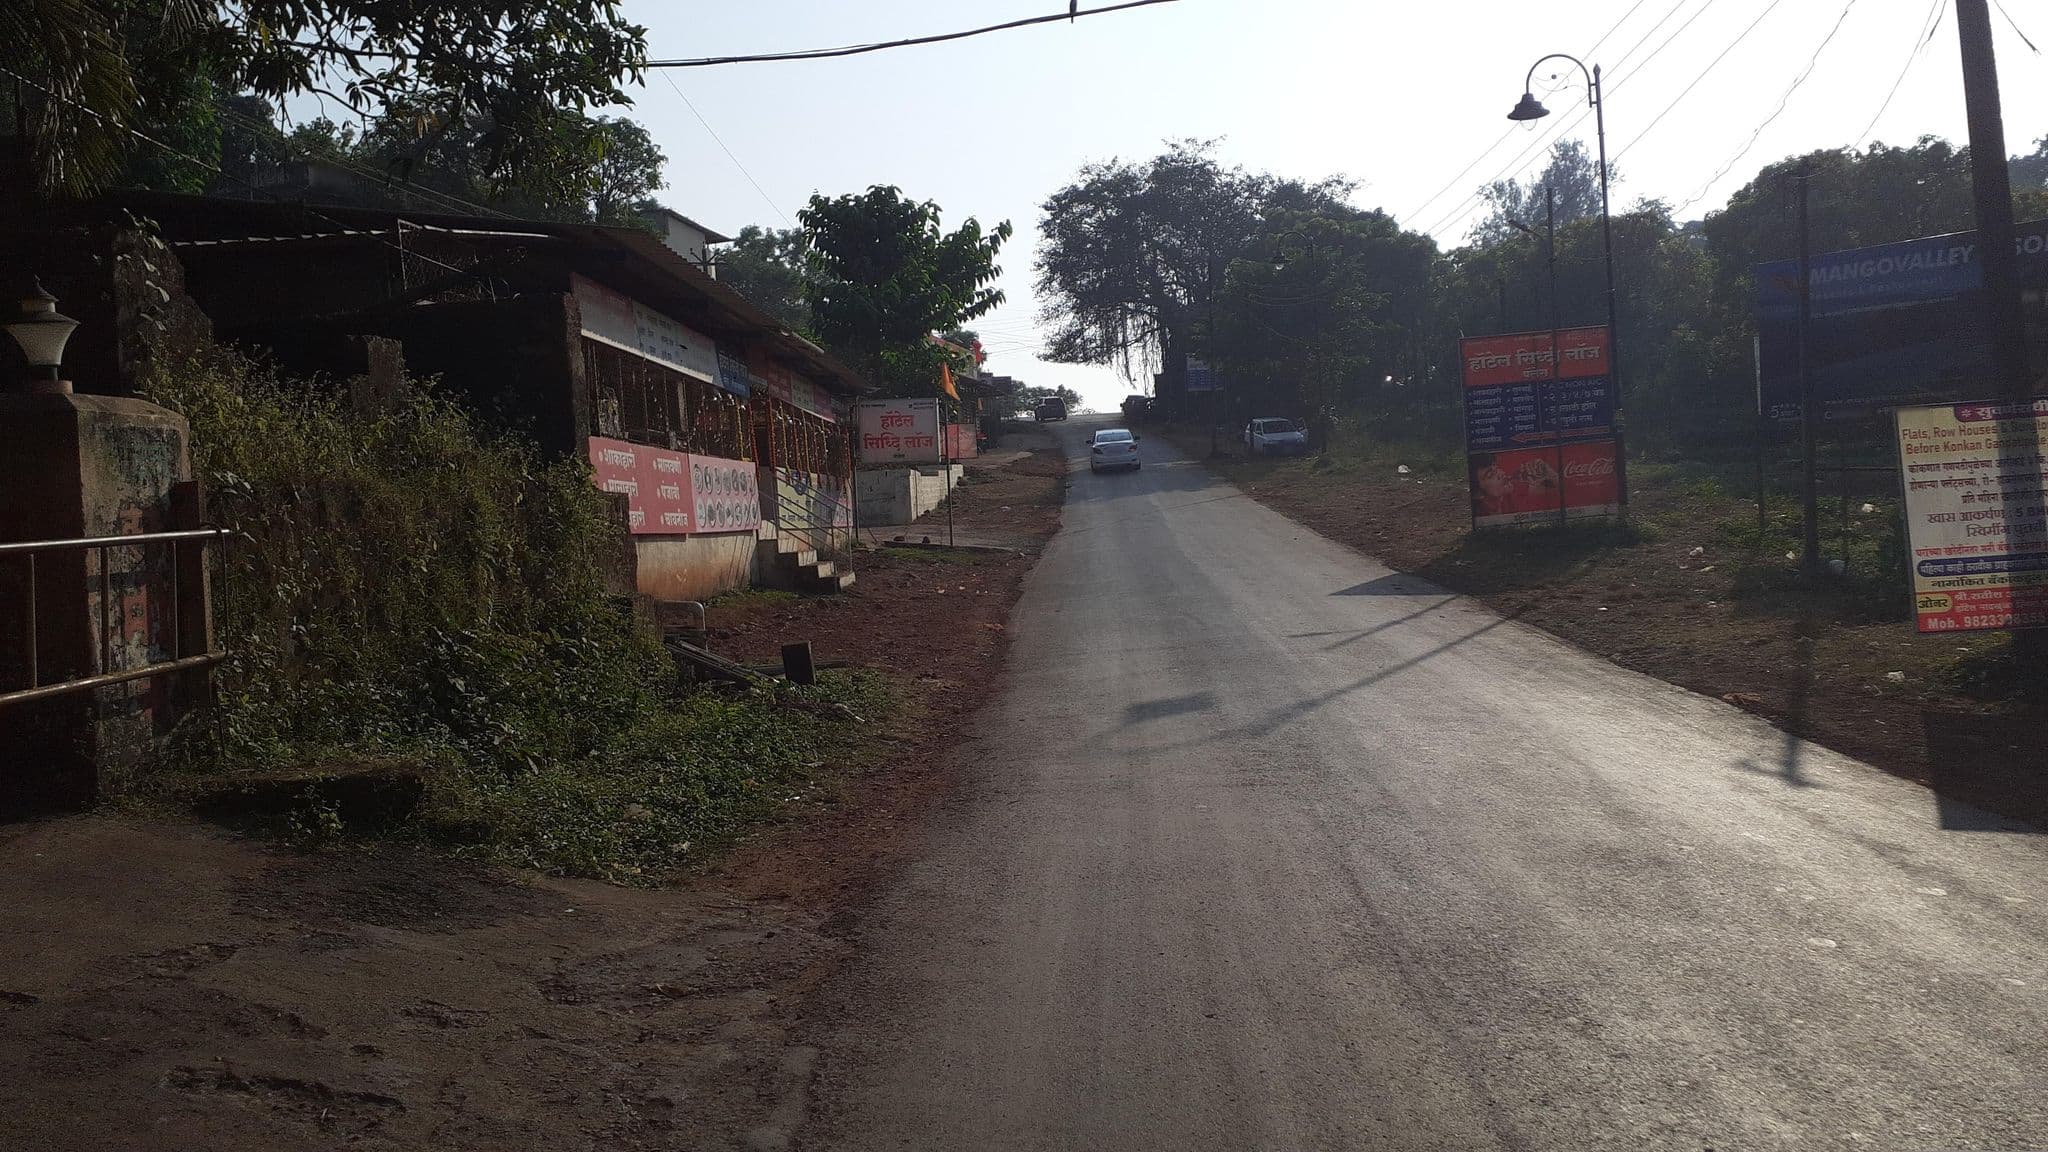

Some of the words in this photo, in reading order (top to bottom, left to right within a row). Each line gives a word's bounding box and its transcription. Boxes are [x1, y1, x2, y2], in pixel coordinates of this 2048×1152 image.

[1809, 245, 1975, 284] MANGOVALLEY
[1468, 351, 1511, 373] हॉटेल
[880, 410, 915, 431] हॉटेल
[904, 431, 935, 449] लॉज
[1902, 428, 1931, 441] Flats,
[1933, 426, 1956, 439] Row
[1958, 424, 1998, 437] Houses
[1905, 444, 1941, 456] Before
[1943, 440, 1982, 453] Konkan
[1917, 596, 1948, 609] ओनर
[1926, 616, 1960, 630] Mob.
